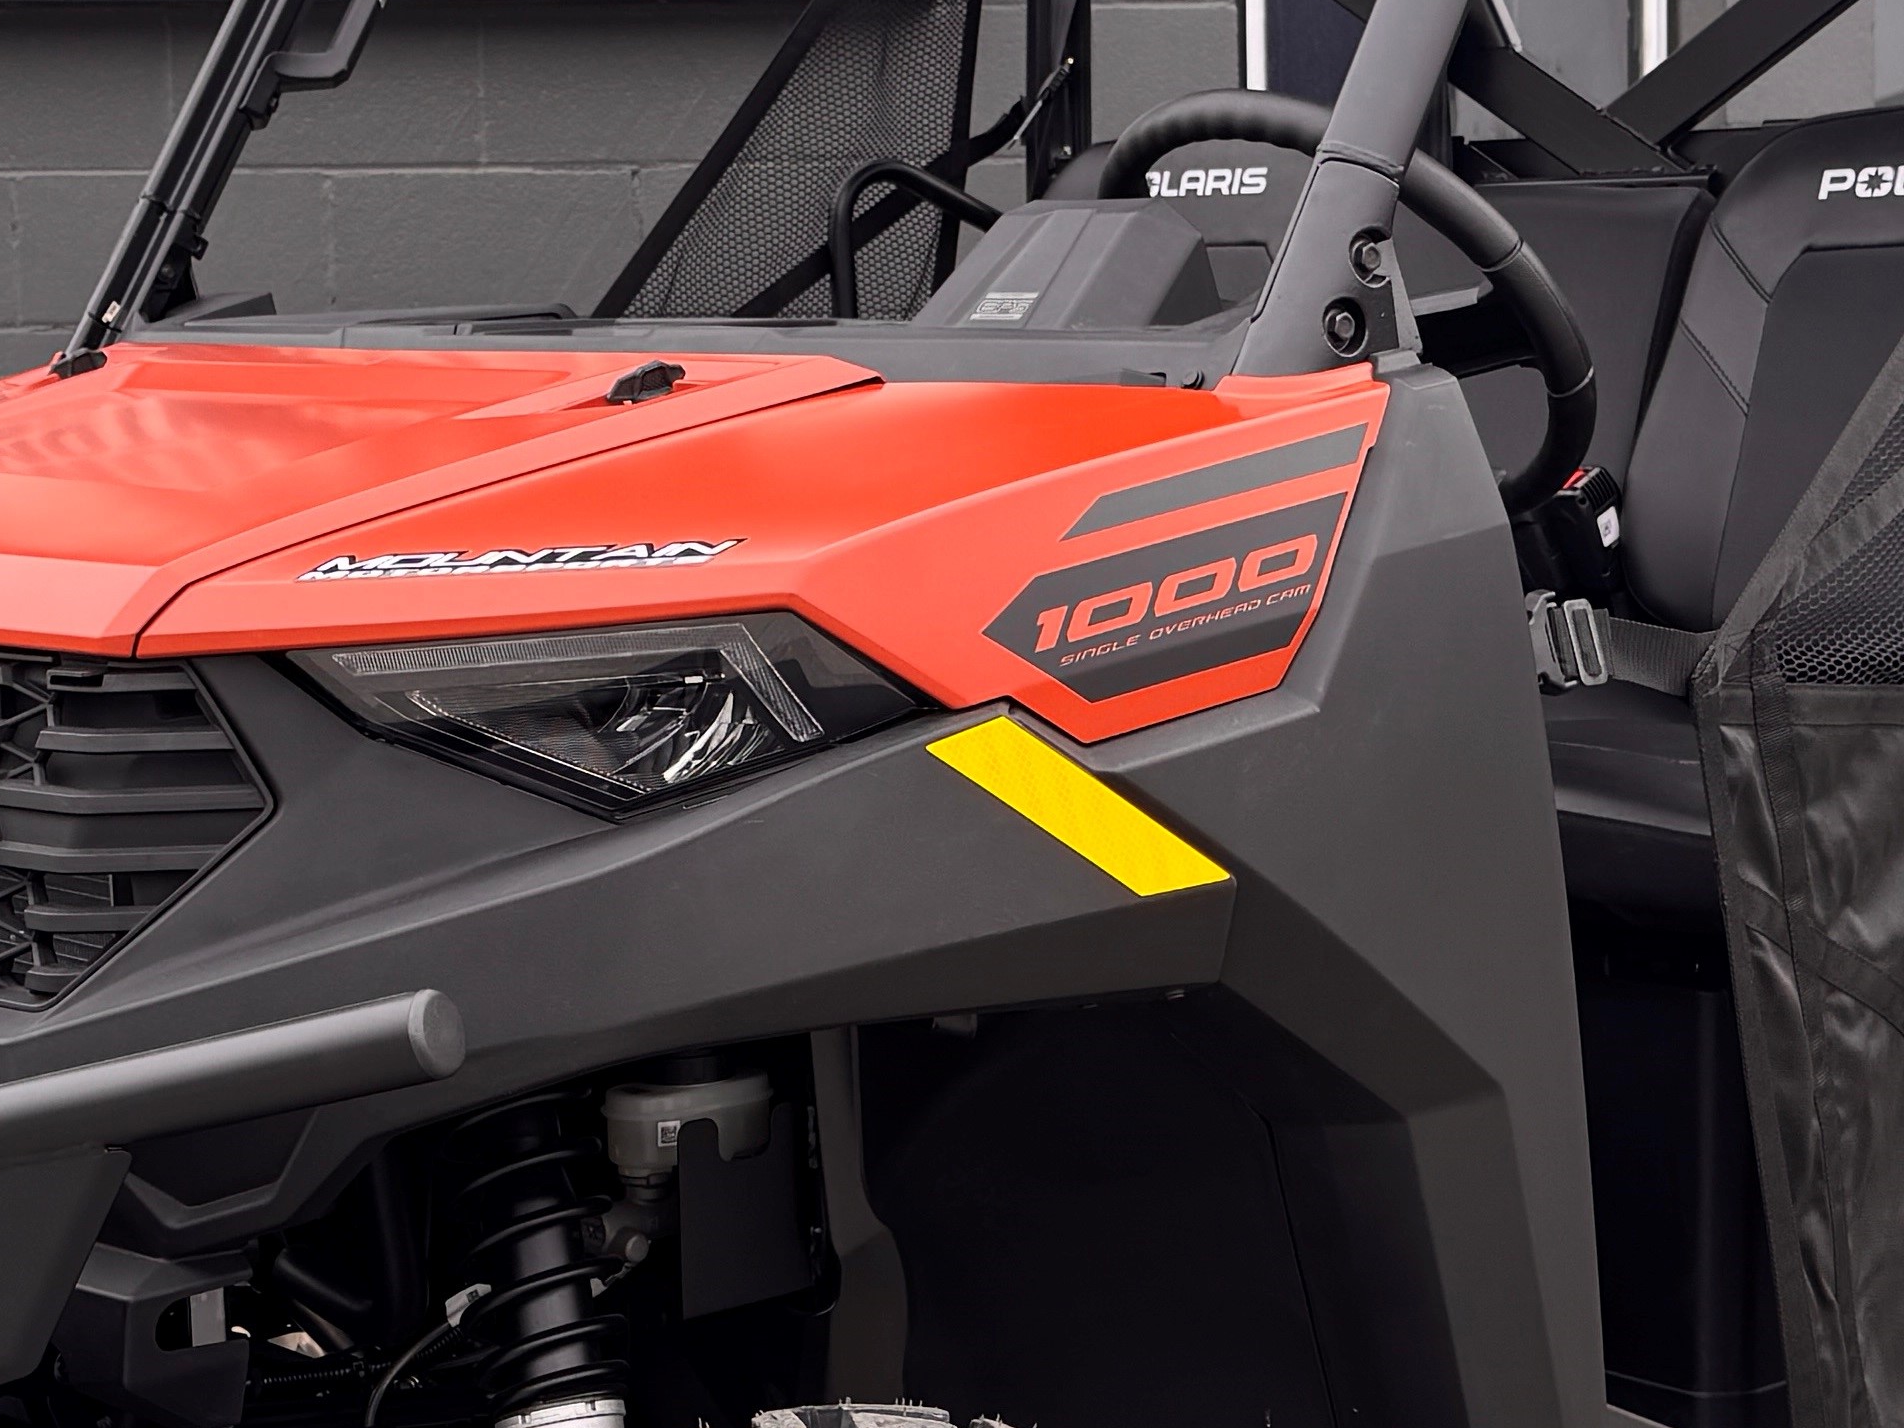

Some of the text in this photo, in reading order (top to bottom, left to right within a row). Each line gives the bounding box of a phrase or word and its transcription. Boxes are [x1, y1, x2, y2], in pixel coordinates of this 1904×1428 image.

[1034, 532, 1319, 653] 1000
[1059, 582, 1311, 667] SINGLE OVERHEAD CAM
